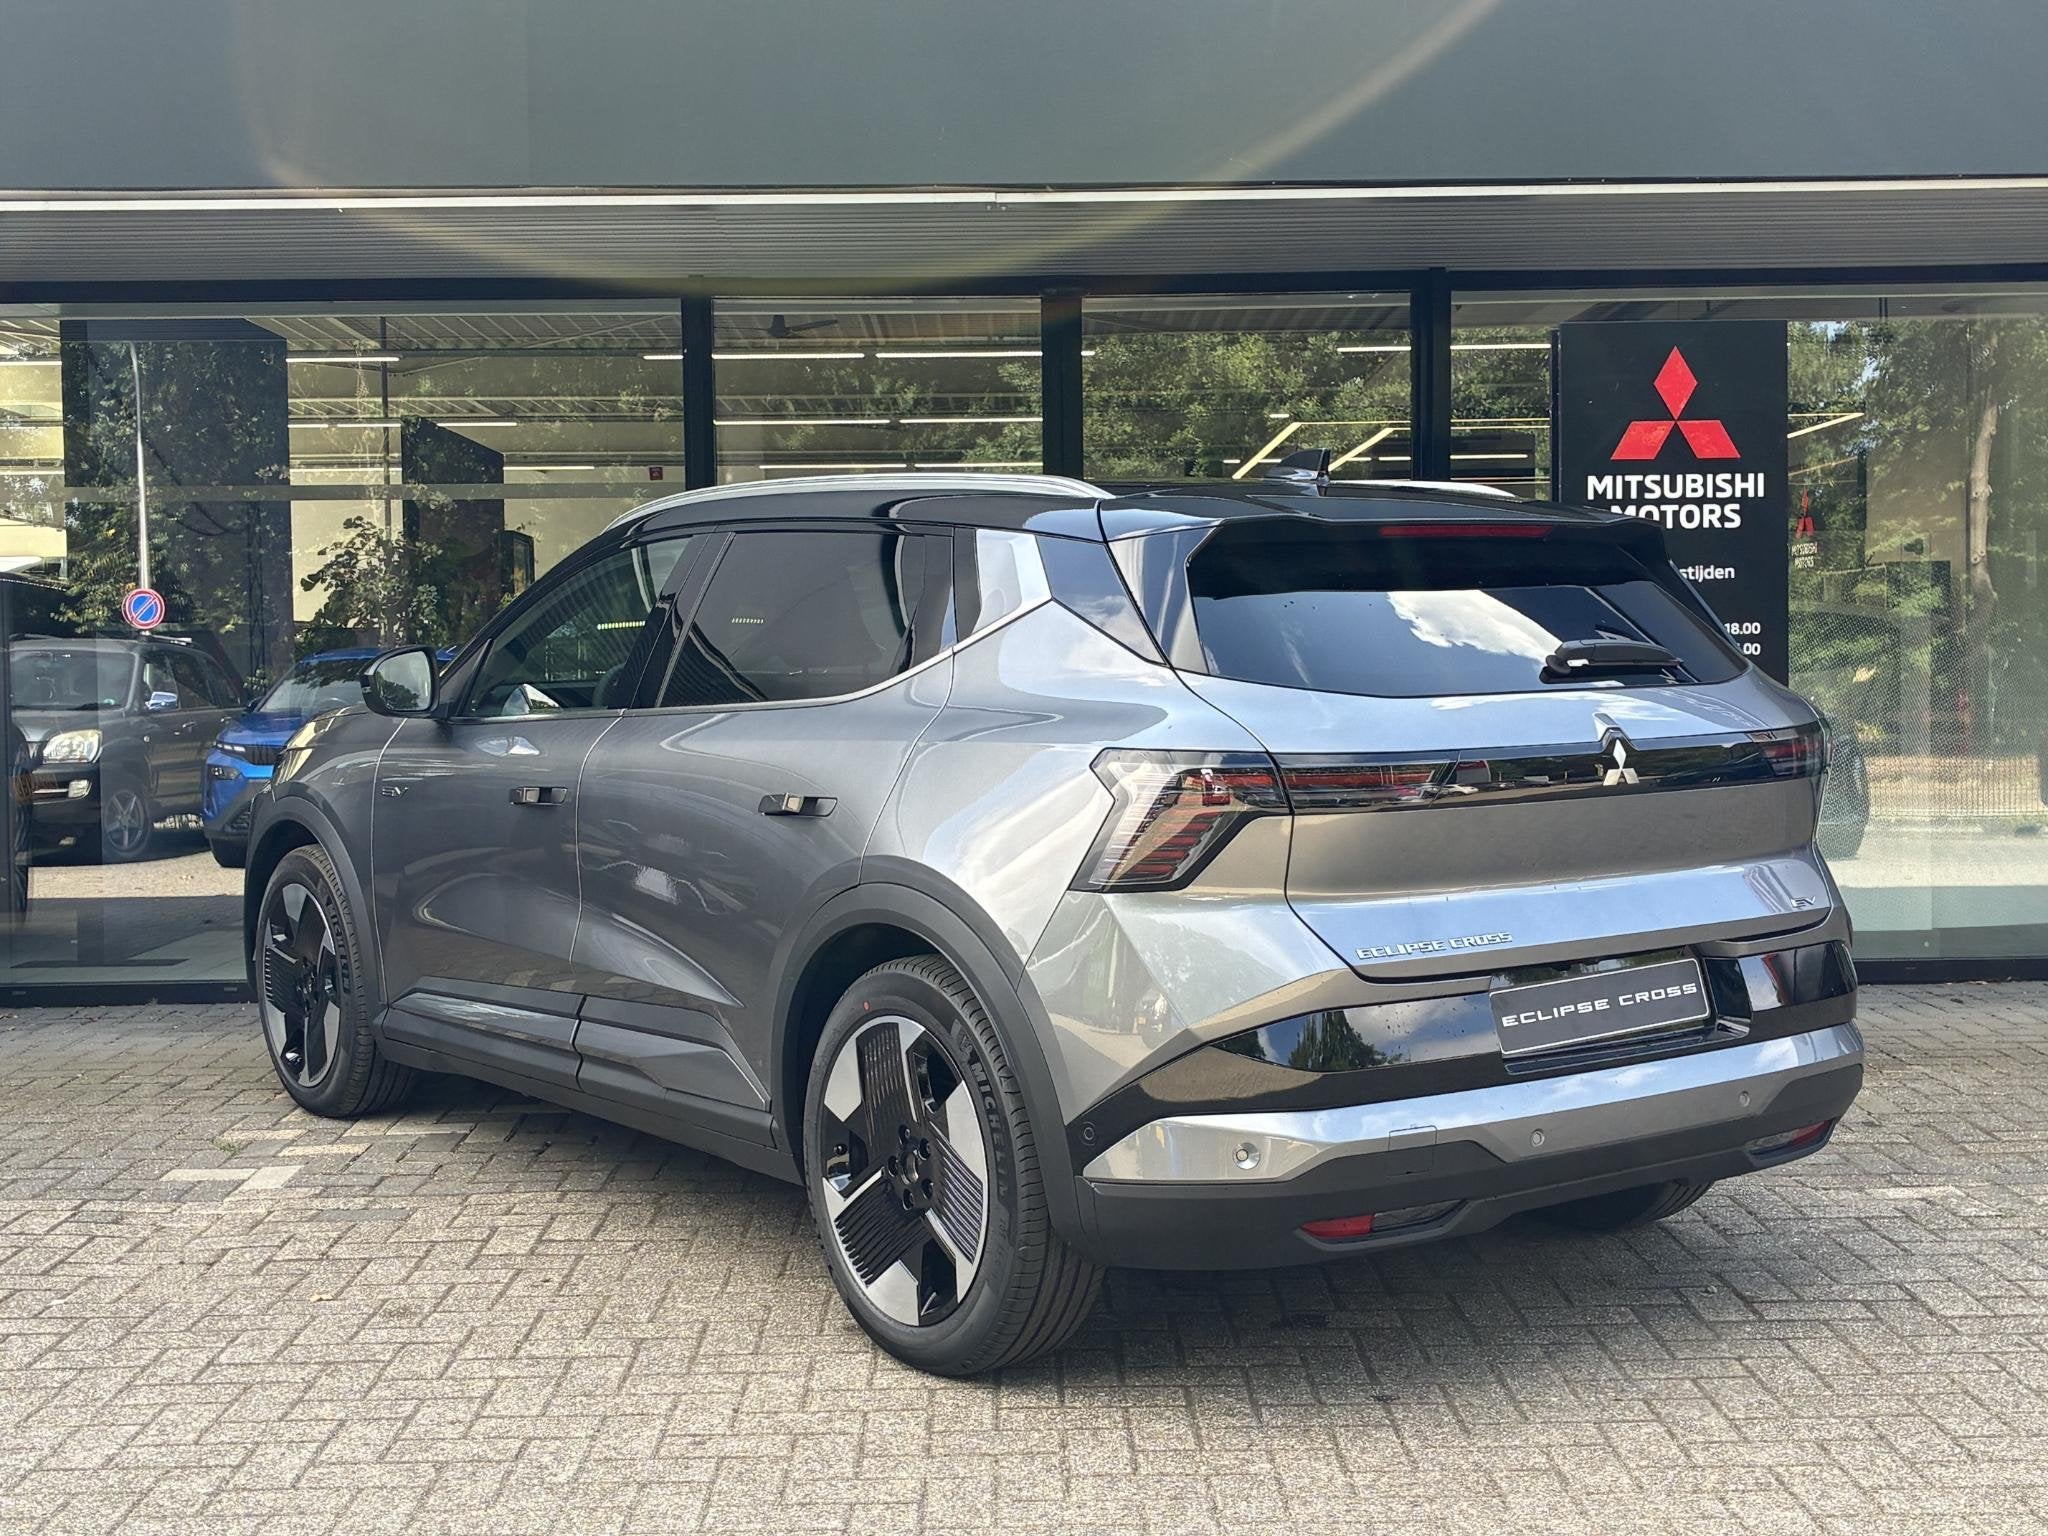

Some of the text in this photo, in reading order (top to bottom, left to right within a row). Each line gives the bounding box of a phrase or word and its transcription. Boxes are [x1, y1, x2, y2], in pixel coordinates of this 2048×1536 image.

[1587, 473, 1765, 500] MITSUBISHI
[1679, 565, 1735, 583] stijden
[1790, 895, 1816, 908] EV
[1355, 931, 1513, 960] ECLIPSE CROSS
[1501, 983, 1698, 1028] ECLIPSE CROSS
[970, 1062, 1009, 1197] MICHELIN
